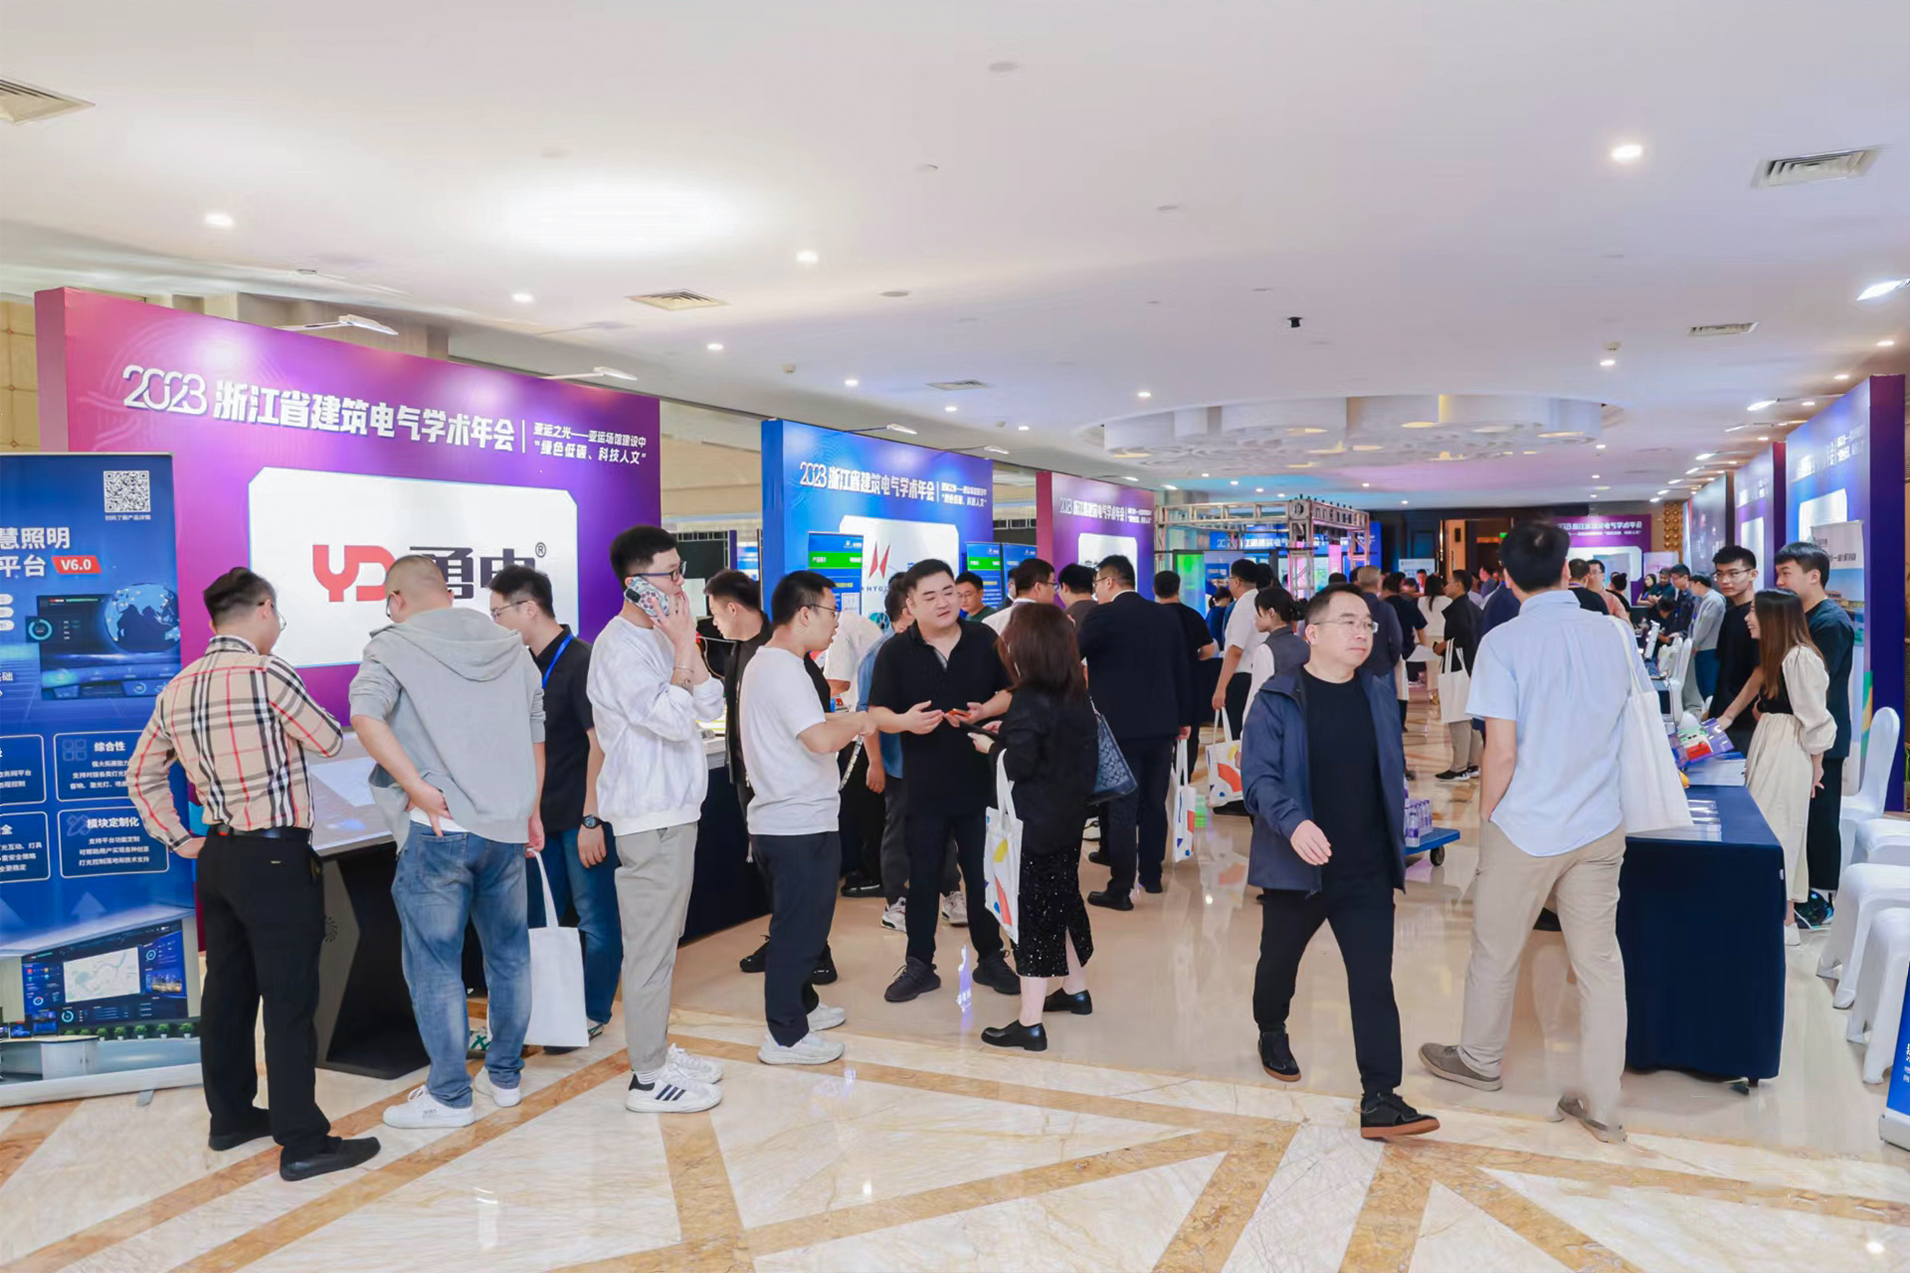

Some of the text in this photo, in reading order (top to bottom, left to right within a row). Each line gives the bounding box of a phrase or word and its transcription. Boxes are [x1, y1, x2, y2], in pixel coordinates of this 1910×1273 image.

[122, 363, 515, 453] 2023 浙江省建筑电气学术年会
[533, 421, 647, 448] 亚运之光——亚运场馆建设中
[800, 461, 828, 489] 2023
[0, 527, 71, 549] 慧照明
[0, 554, 92, 577] 平台 V6.0
[312, 544, 396, 603] YD
[94, 741, 126, 753] 综合性
[87, 817, 140, 829] 模块定制化
